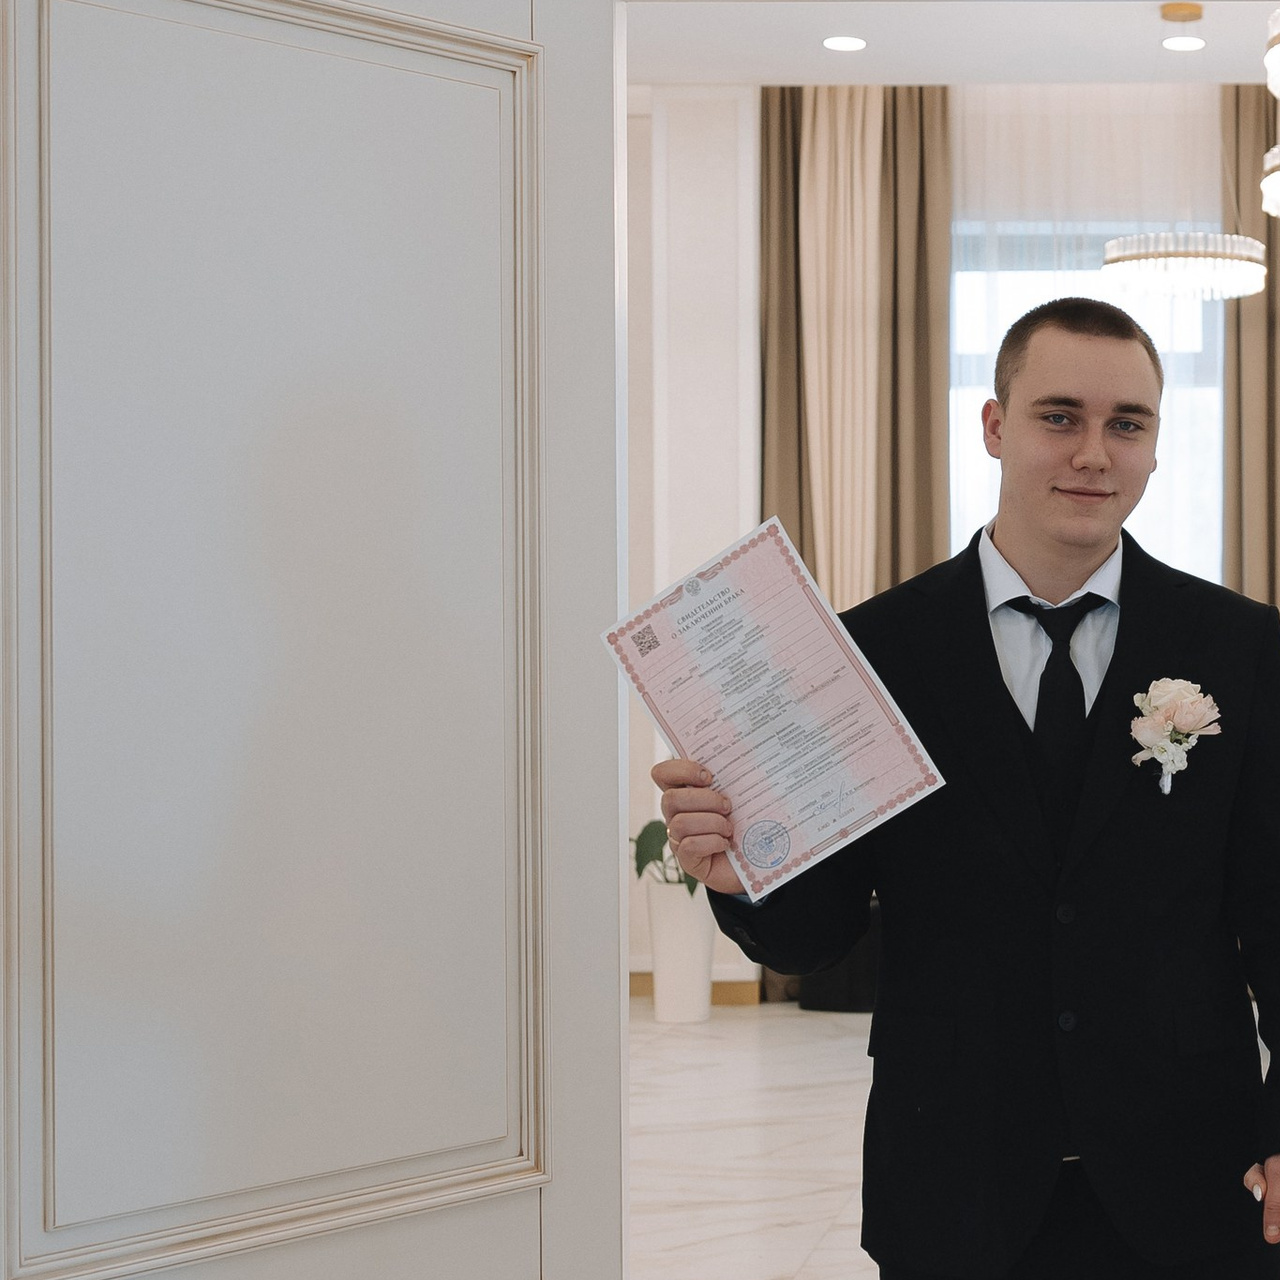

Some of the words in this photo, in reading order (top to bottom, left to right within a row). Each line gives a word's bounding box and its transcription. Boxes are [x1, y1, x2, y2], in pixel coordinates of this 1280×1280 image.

[676, 587, 731, 625] СВИДЕТЕЛЬСТВО
[677, 602, 724, 635] ЗАКЛЮЧЕНИИ
[723, 588, 745, 606] БРАКА
